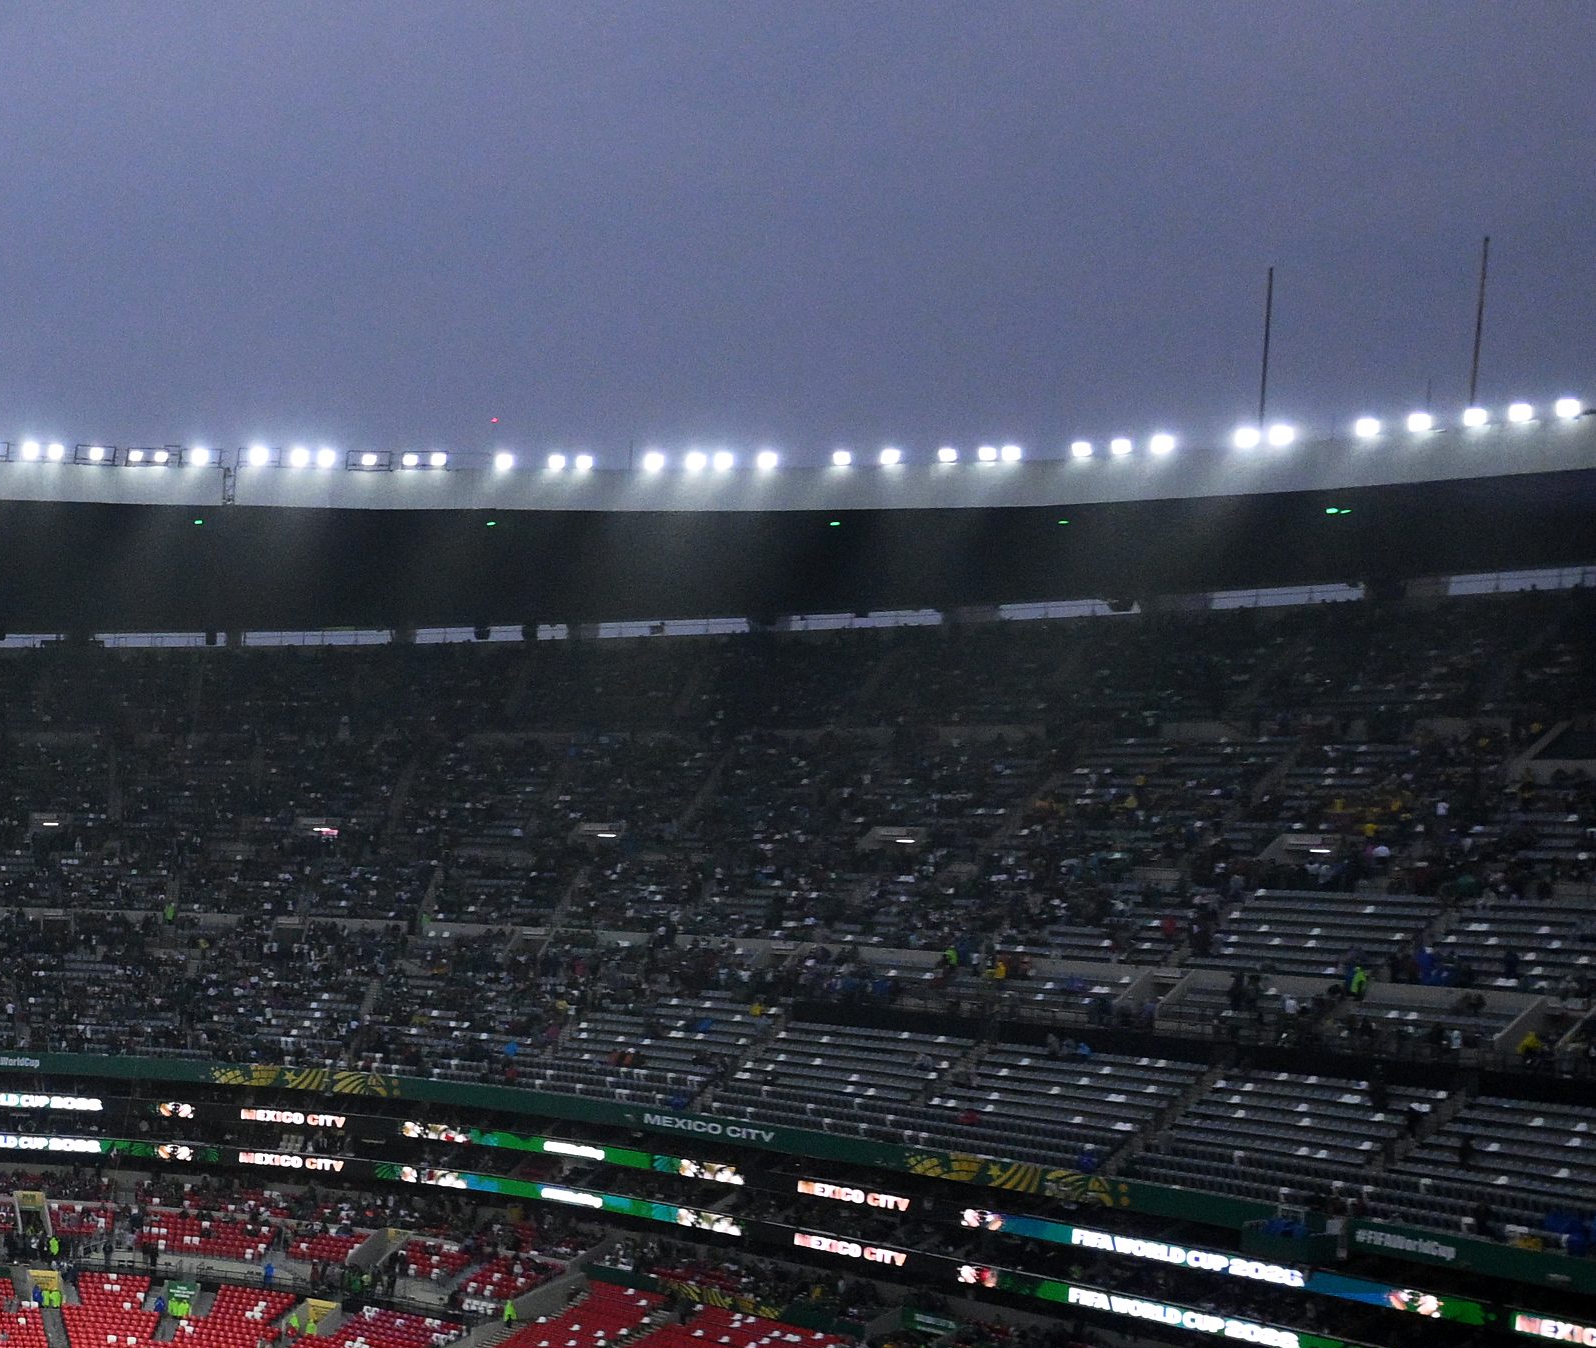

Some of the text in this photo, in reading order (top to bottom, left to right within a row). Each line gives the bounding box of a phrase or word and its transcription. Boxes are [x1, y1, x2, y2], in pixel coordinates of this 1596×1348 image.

[19, 1094, 50, 1108] CUP
[241, 1108, 346, 1128] MEXICO CITY
[644, 1113, 775, 1143] MEXICO CITY
[18, 1136, 49, 1150] CUP
[239, 1152, 344, 1172] MEXICO CITY
[797, 1180, 910, 1211] MEXICO CITY
[794, 1232, 907, 1267] MEXICO CITY
[1187, 1250, 1229, 1271] CUP
[1182, 1311, 1225, 1333] CUP
